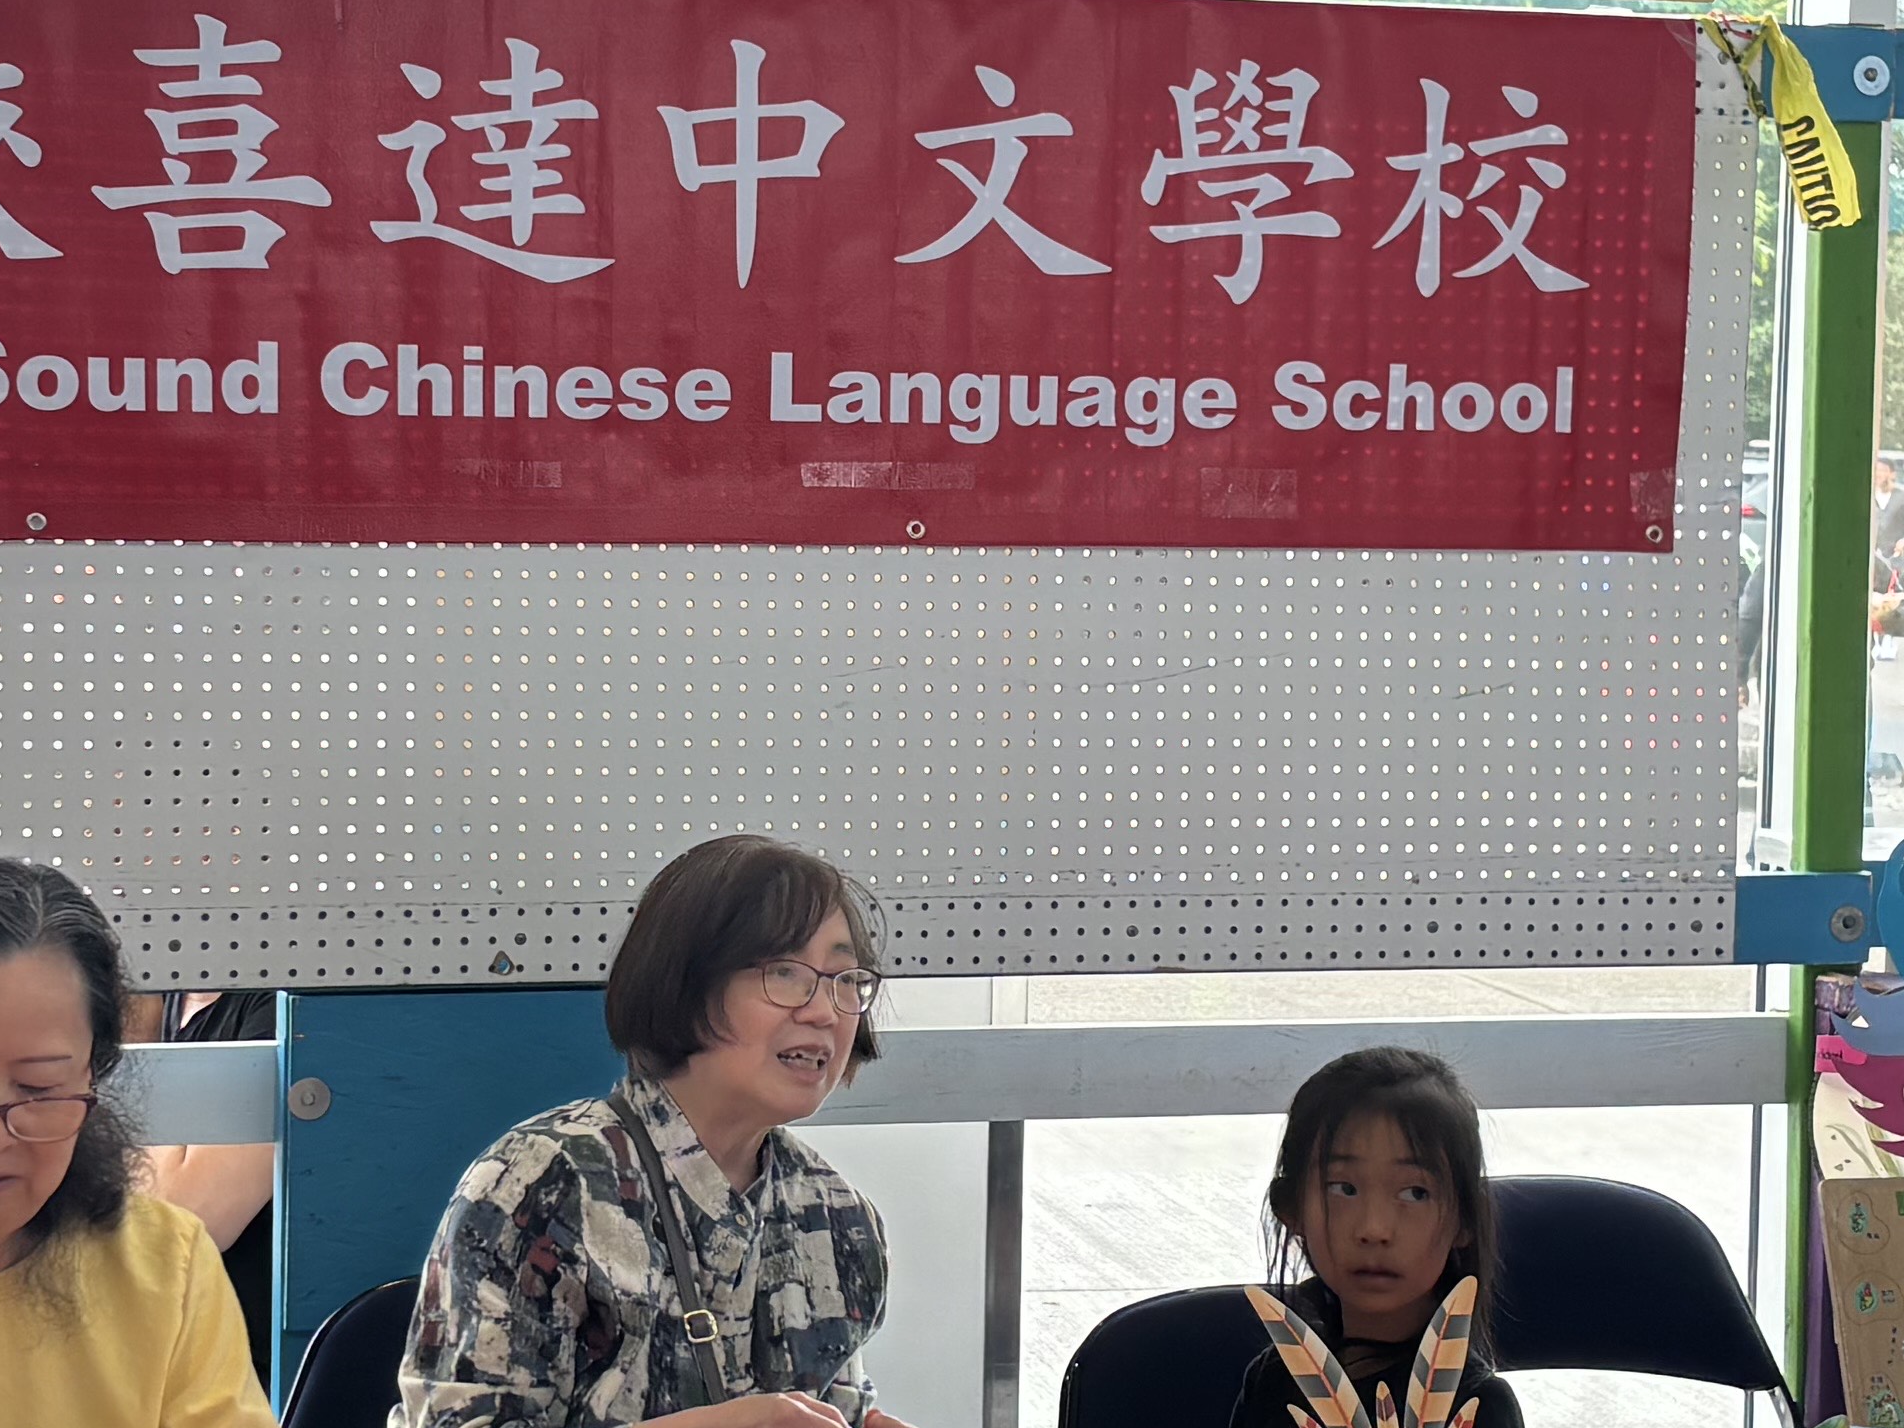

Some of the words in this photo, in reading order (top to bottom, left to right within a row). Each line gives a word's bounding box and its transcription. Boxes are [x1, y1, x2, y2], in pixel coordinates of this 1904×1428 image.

[320, 341, 733, 424] Chinese
[769, 350, 1239, 450] Language
[1272, 360, 1575, 436] School
